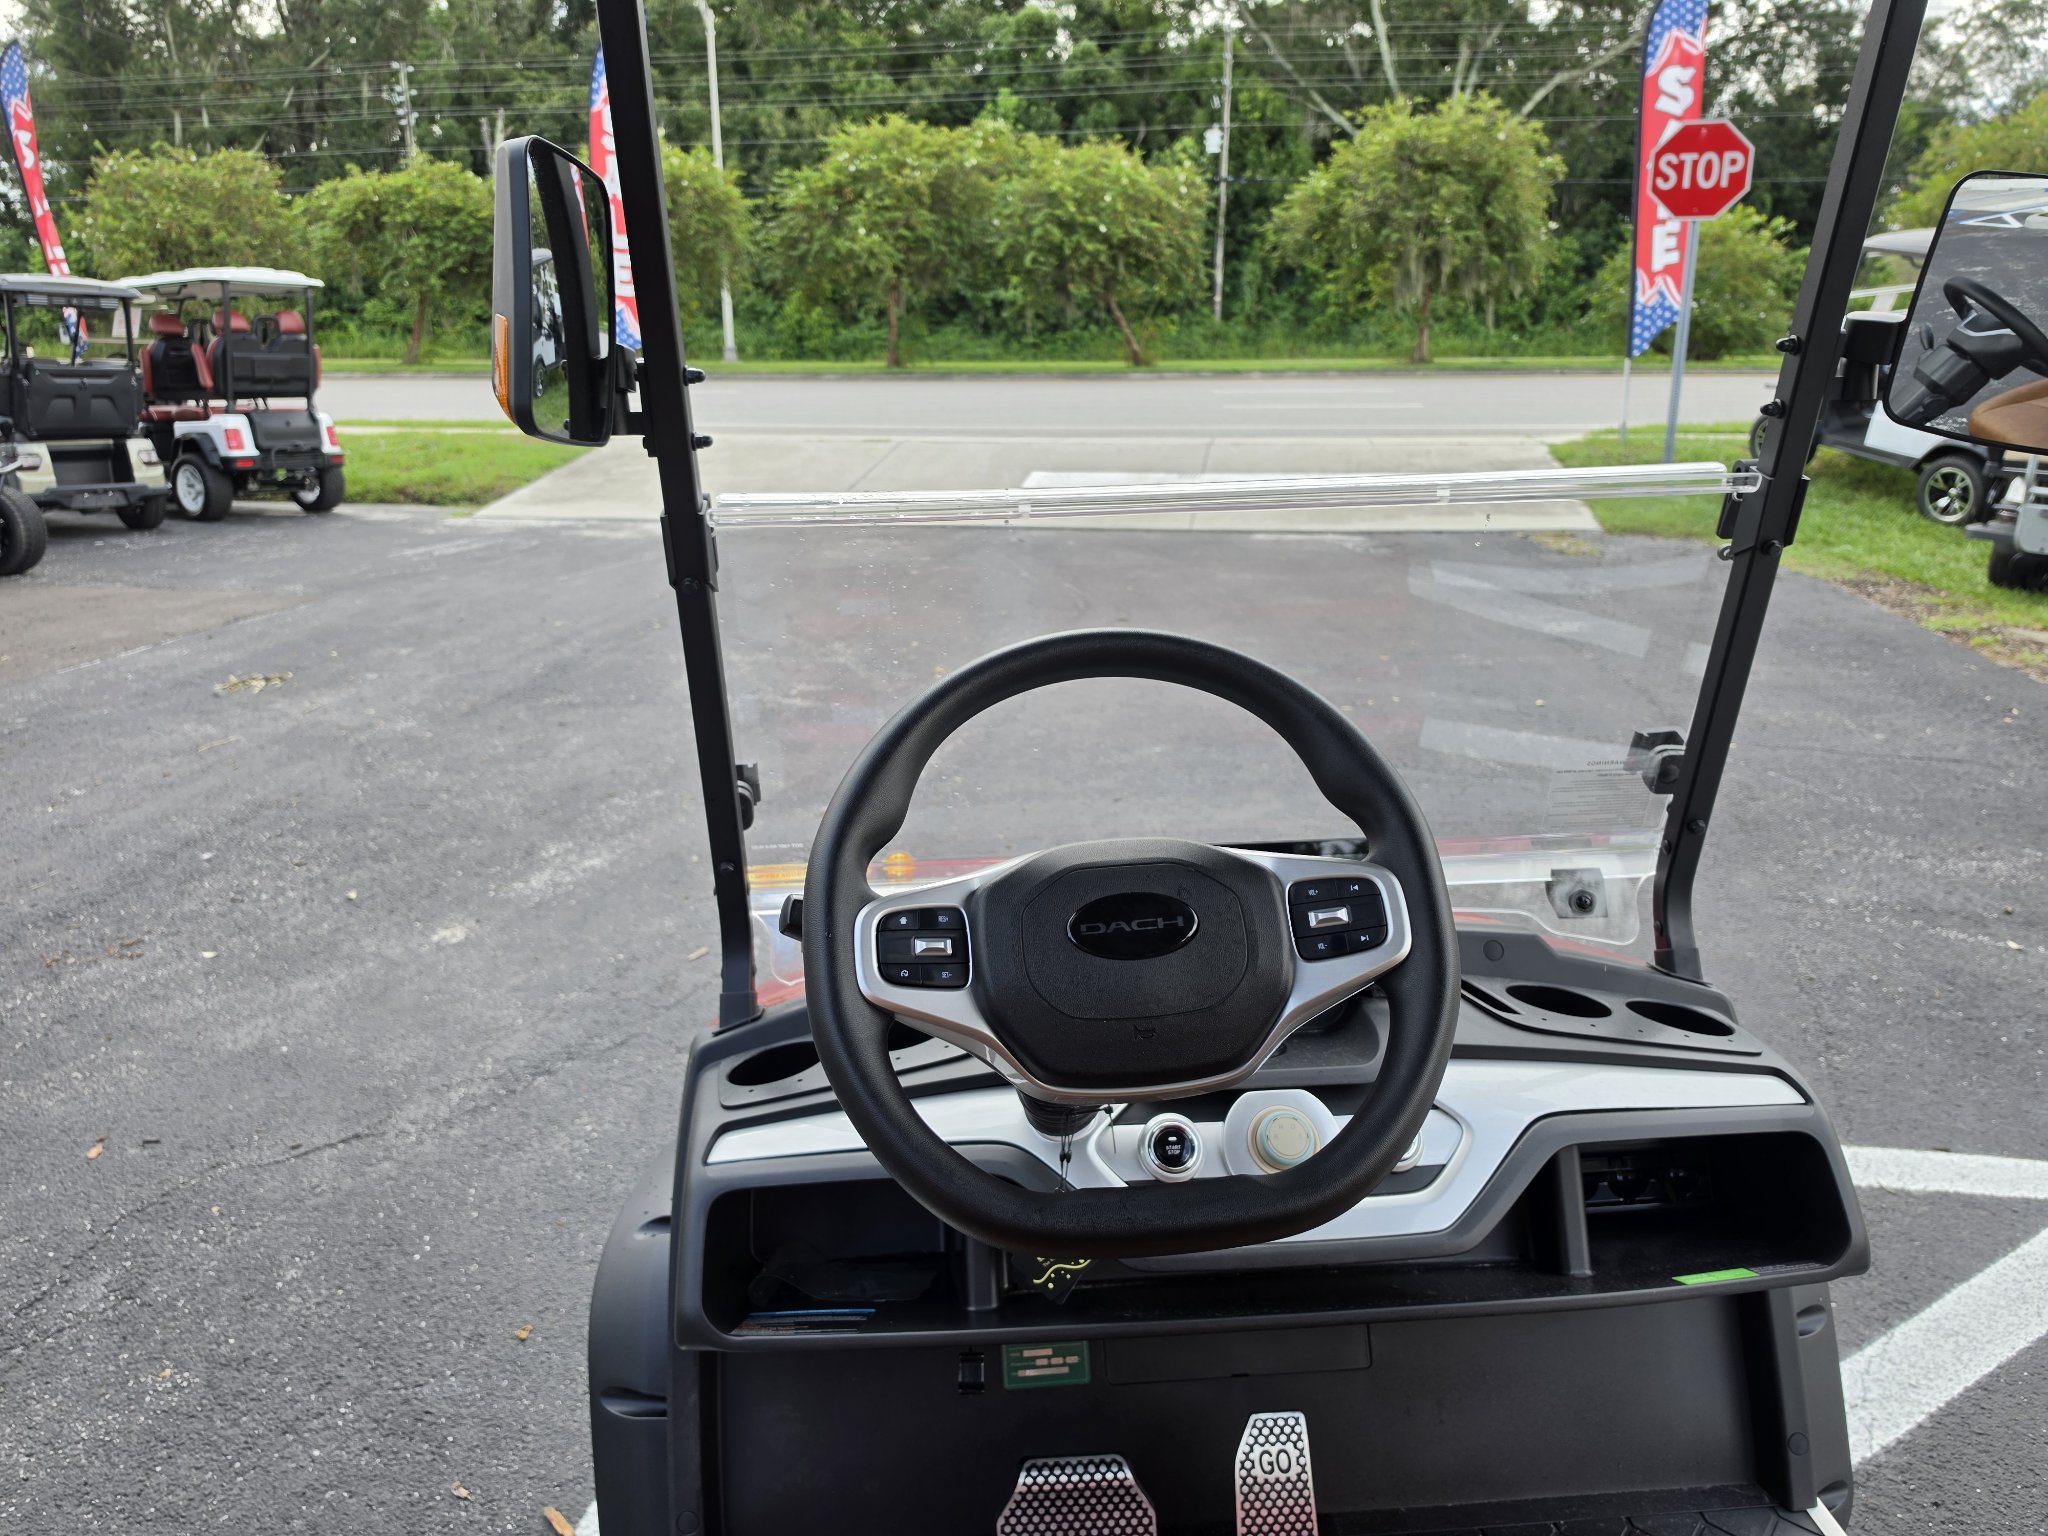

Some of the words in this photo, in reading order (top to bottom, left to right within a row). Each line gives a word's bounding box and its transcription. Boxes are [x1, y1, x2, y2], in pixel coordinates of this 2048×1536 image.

[1646, 64, 1697, 272] SE
[1655, 151, 1746, 191] STOP
[1080, 916, 1184, 935] DACH
[1259, 1448, 1292, 1475] GO
